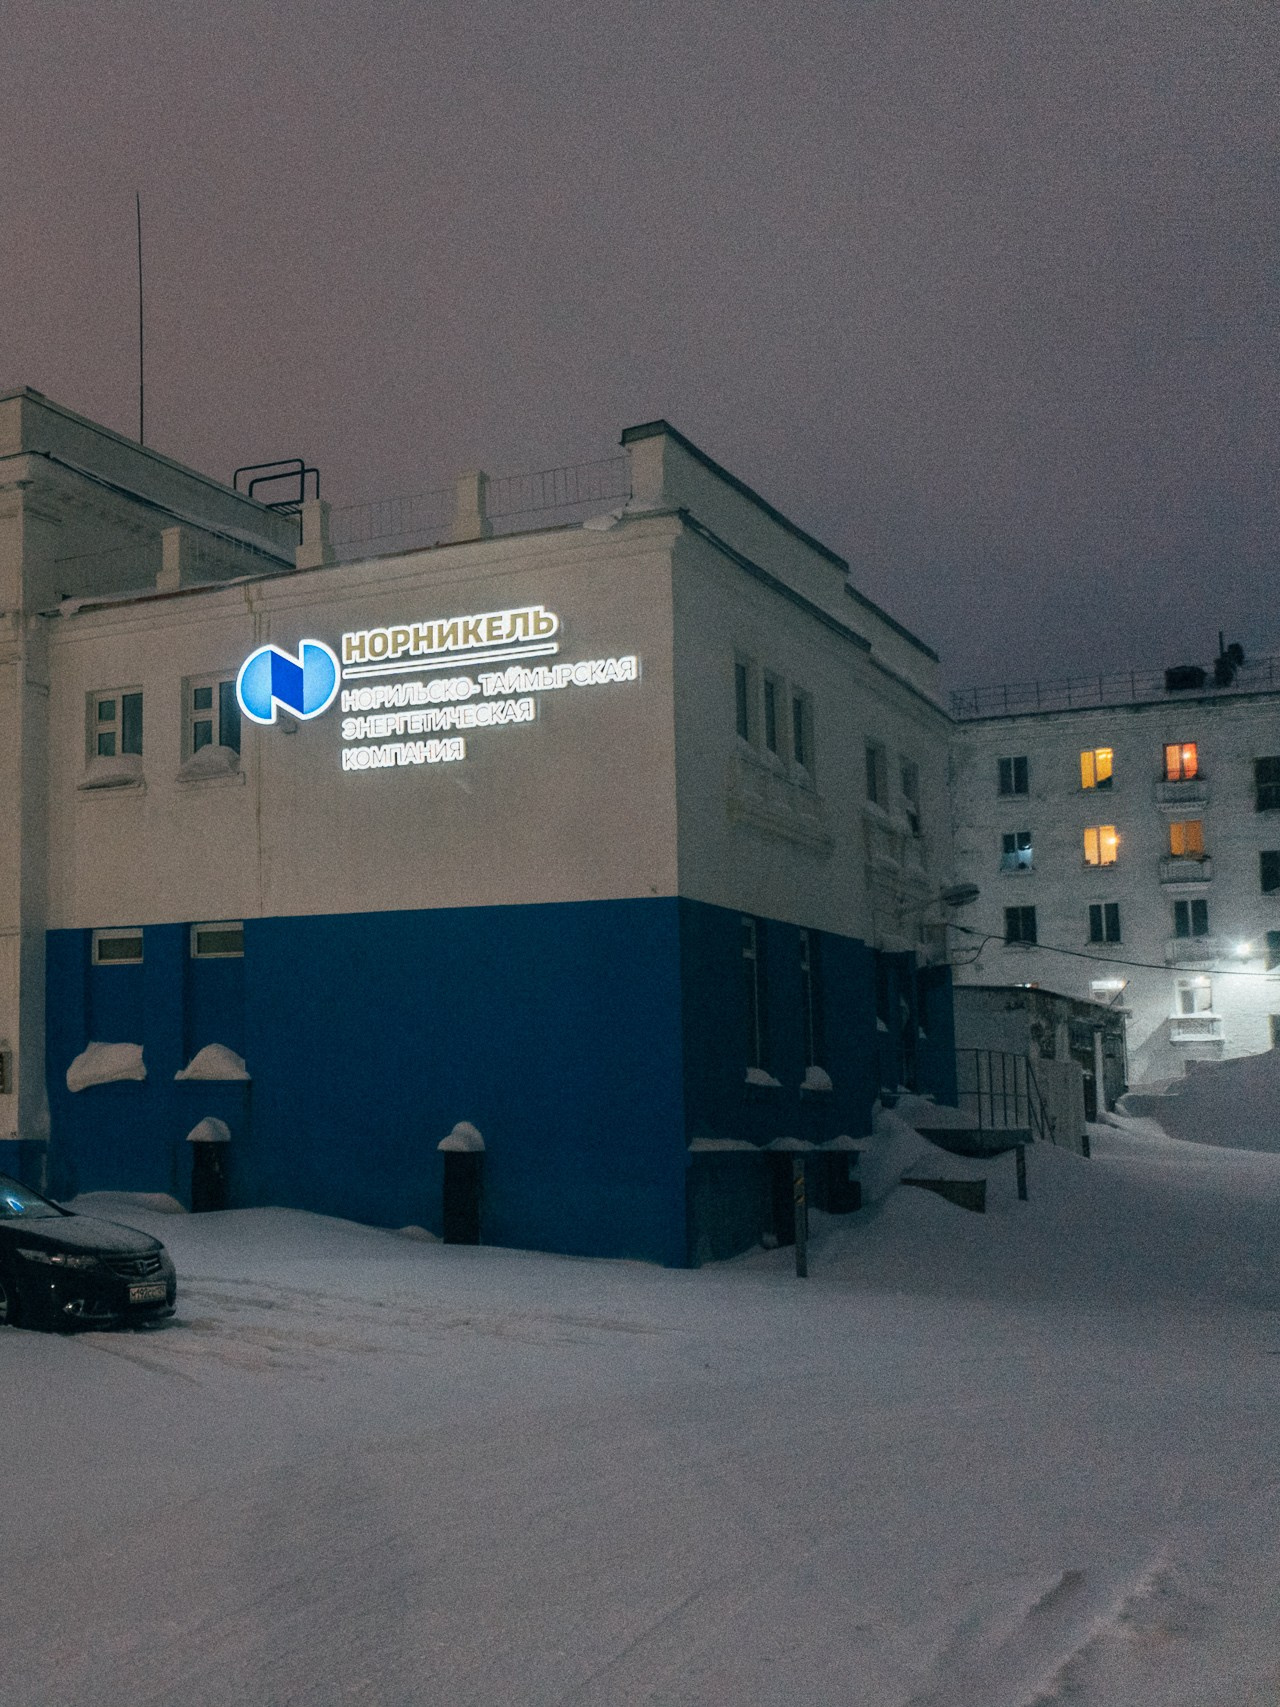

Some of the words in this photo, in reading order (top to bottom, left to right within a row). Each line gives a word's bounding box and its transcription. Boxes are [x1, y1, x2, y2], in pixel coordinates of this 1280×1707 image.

[343, 606, 558, 663] НОРНИКЕЛЬ
[341, 656, 637, 712] НОРИЛЬСКО-ТАЙМЫРСКАЯ
[342, 698, 535, 740] ЭНЕРГЕТИЧЕСКАЯ
[342, 738, 465, 771] КОМПАНИЯ
